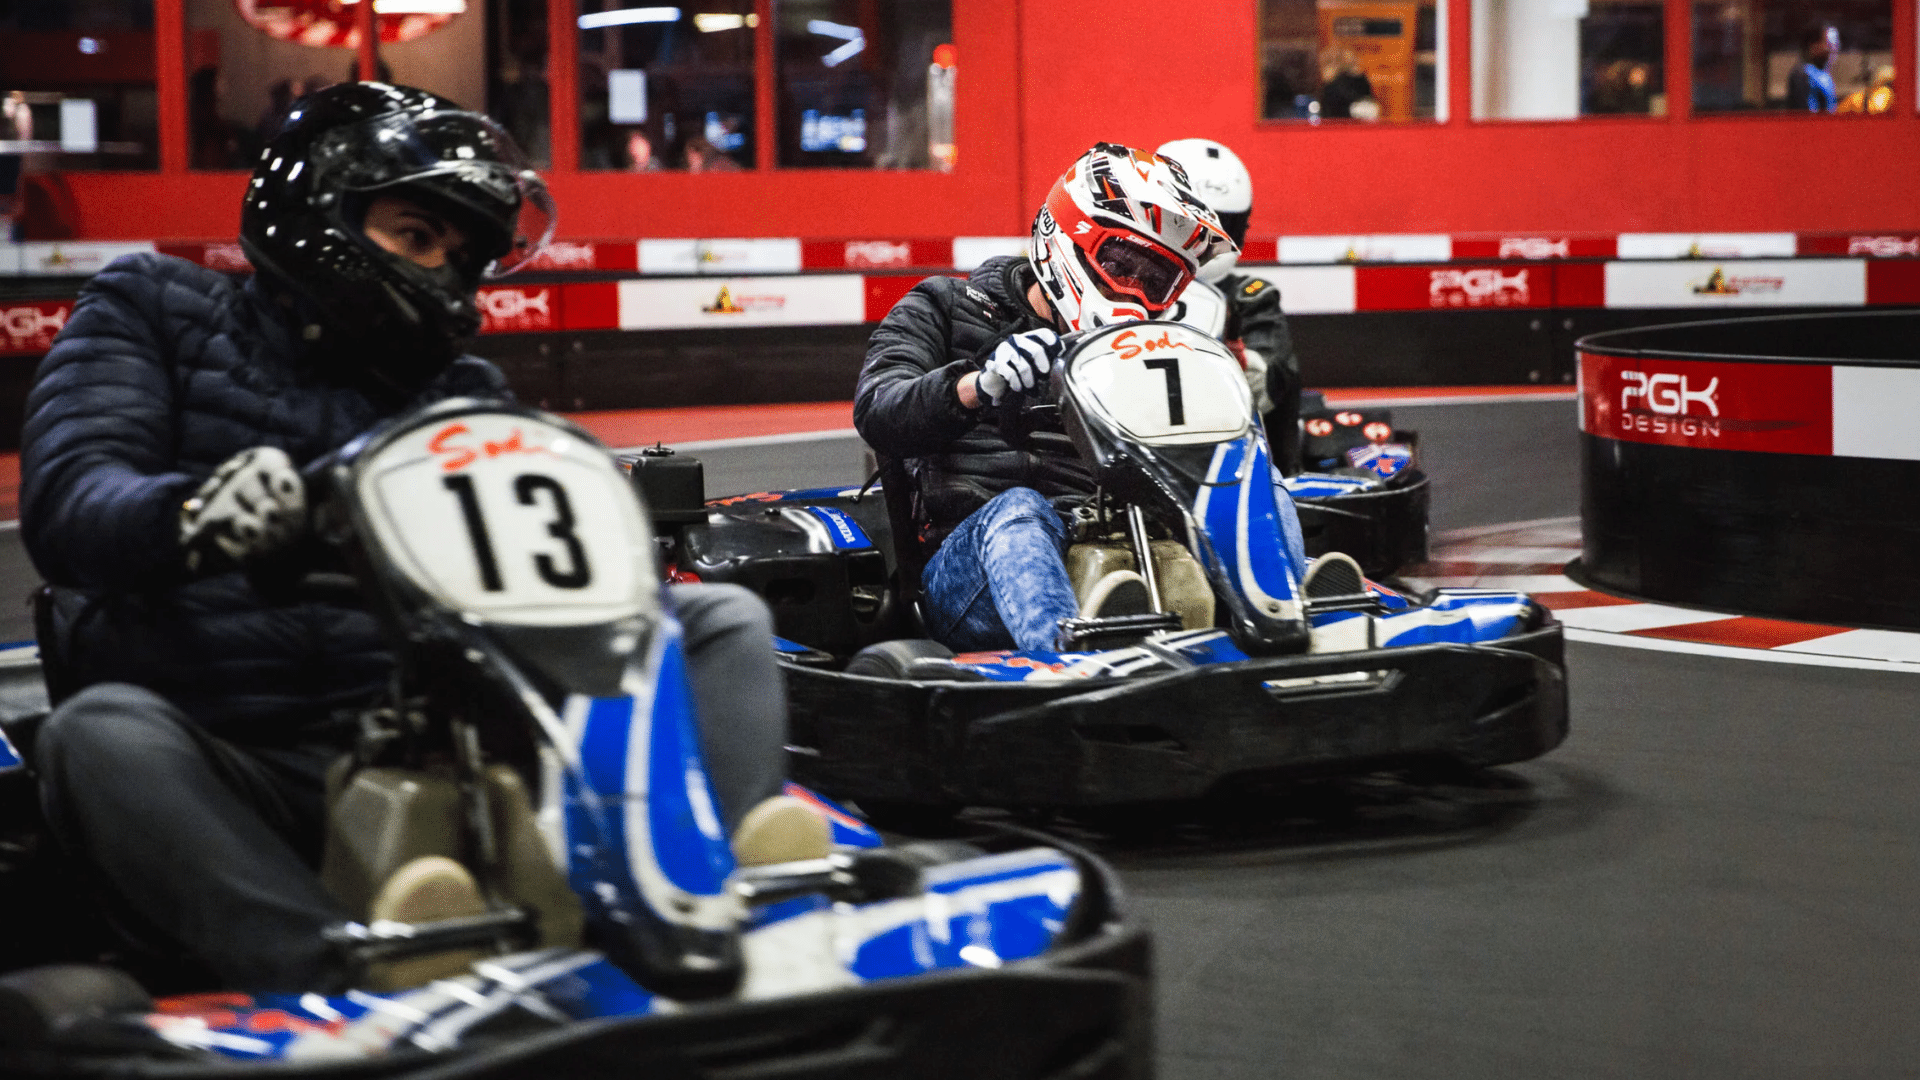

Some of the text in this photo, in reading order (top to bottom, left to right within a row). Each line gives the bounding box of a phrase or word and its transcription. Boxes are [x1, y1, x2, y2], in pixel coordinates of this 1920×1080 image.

[1429, 269, 1529, 296] PGK
[1621, 370, 1719, 417] PGK
[1621, 412, 1720, 437] DESIGN
[442, 473, 592, 593] 13
